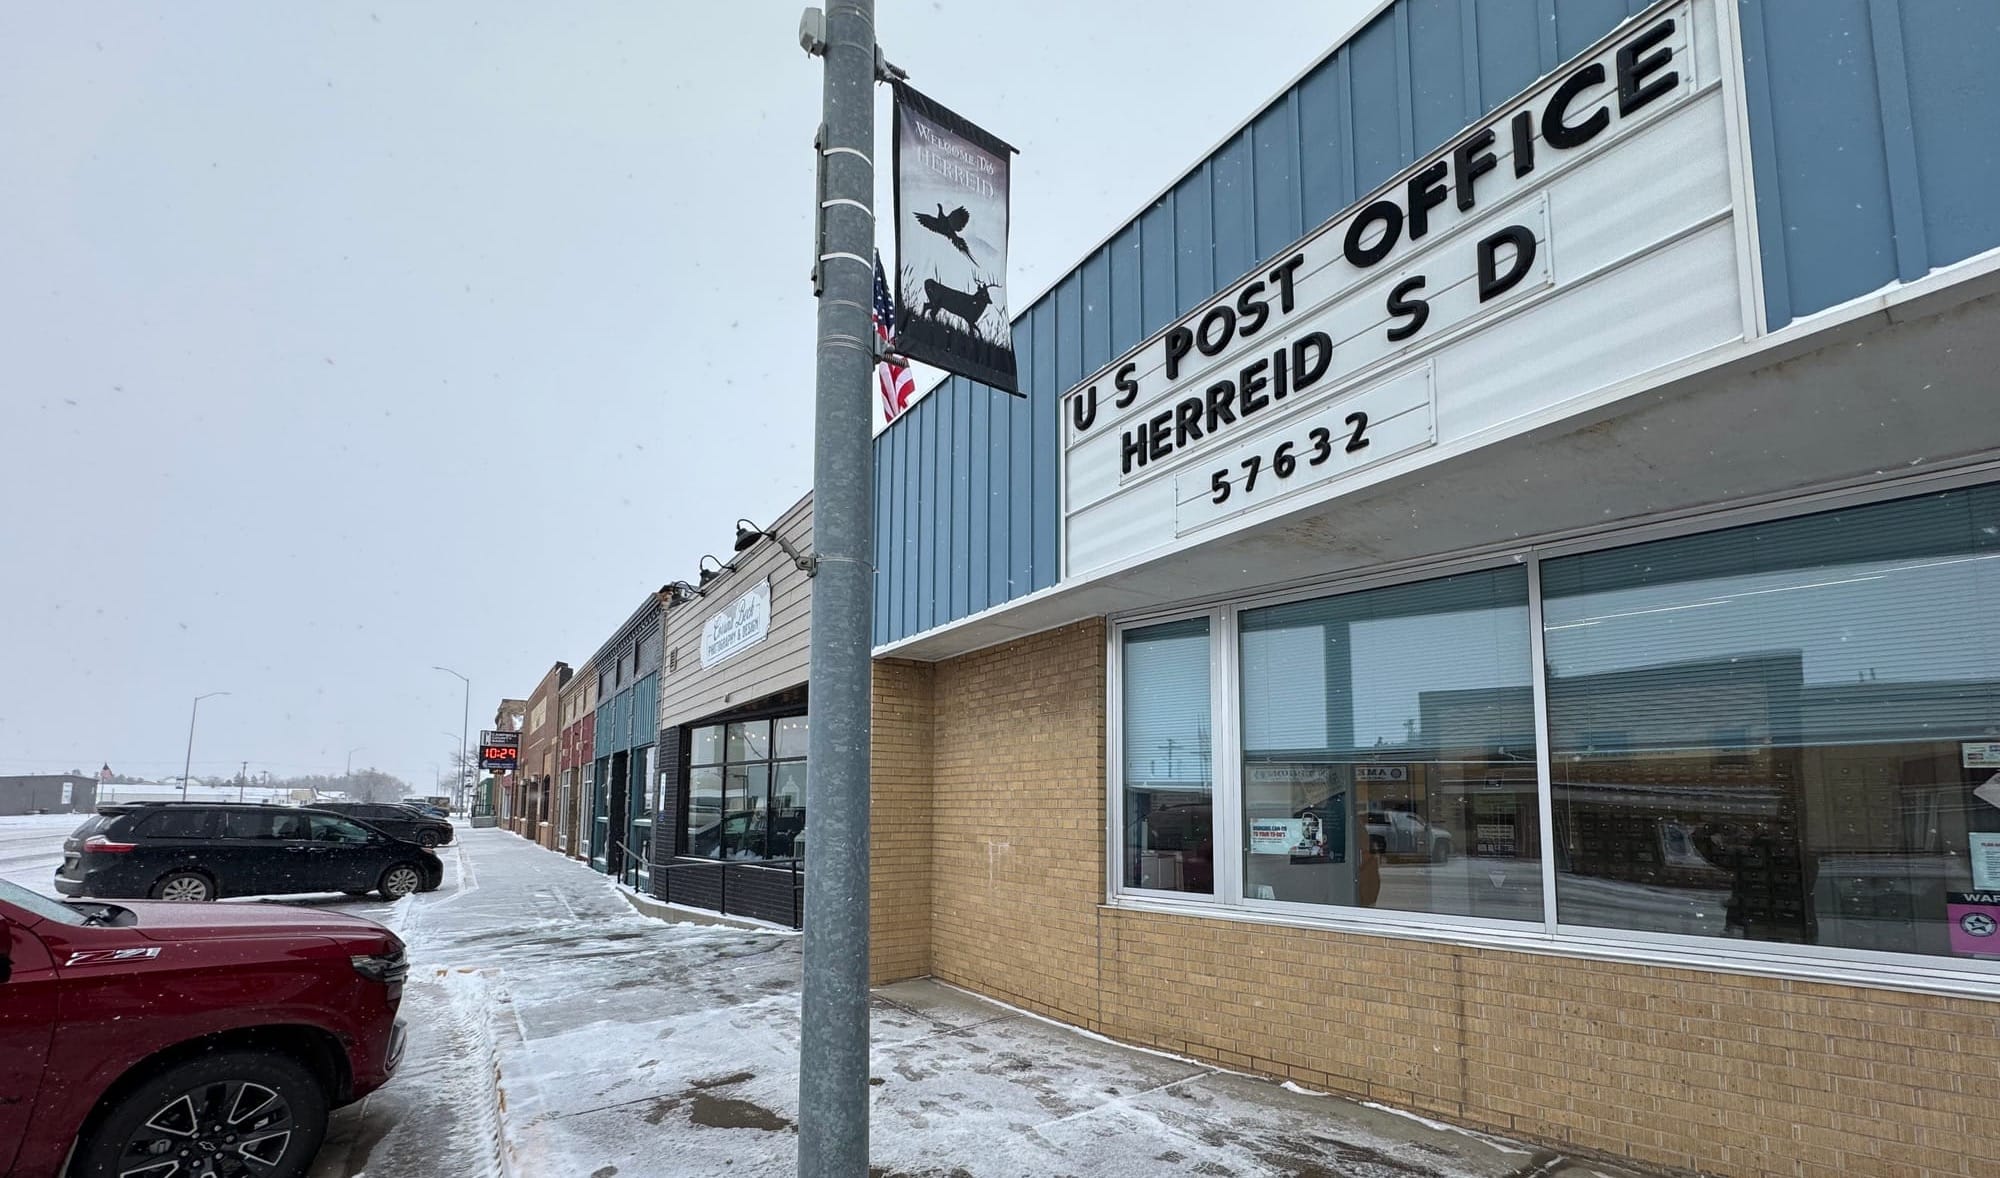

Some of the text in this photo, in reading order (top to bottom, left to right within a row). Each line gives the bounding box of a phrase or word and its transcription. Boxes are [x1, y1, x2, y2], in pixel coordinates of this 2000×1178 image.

[915, 120, 976, 167] WELCOME
[918, 146, 994, 198] HERREID
[1074, 18, 1679, 431] U S POST OFFICE
[1122, 225, 1537, 475] HERREID S D
[485, 748, 516, 759] 10:29
